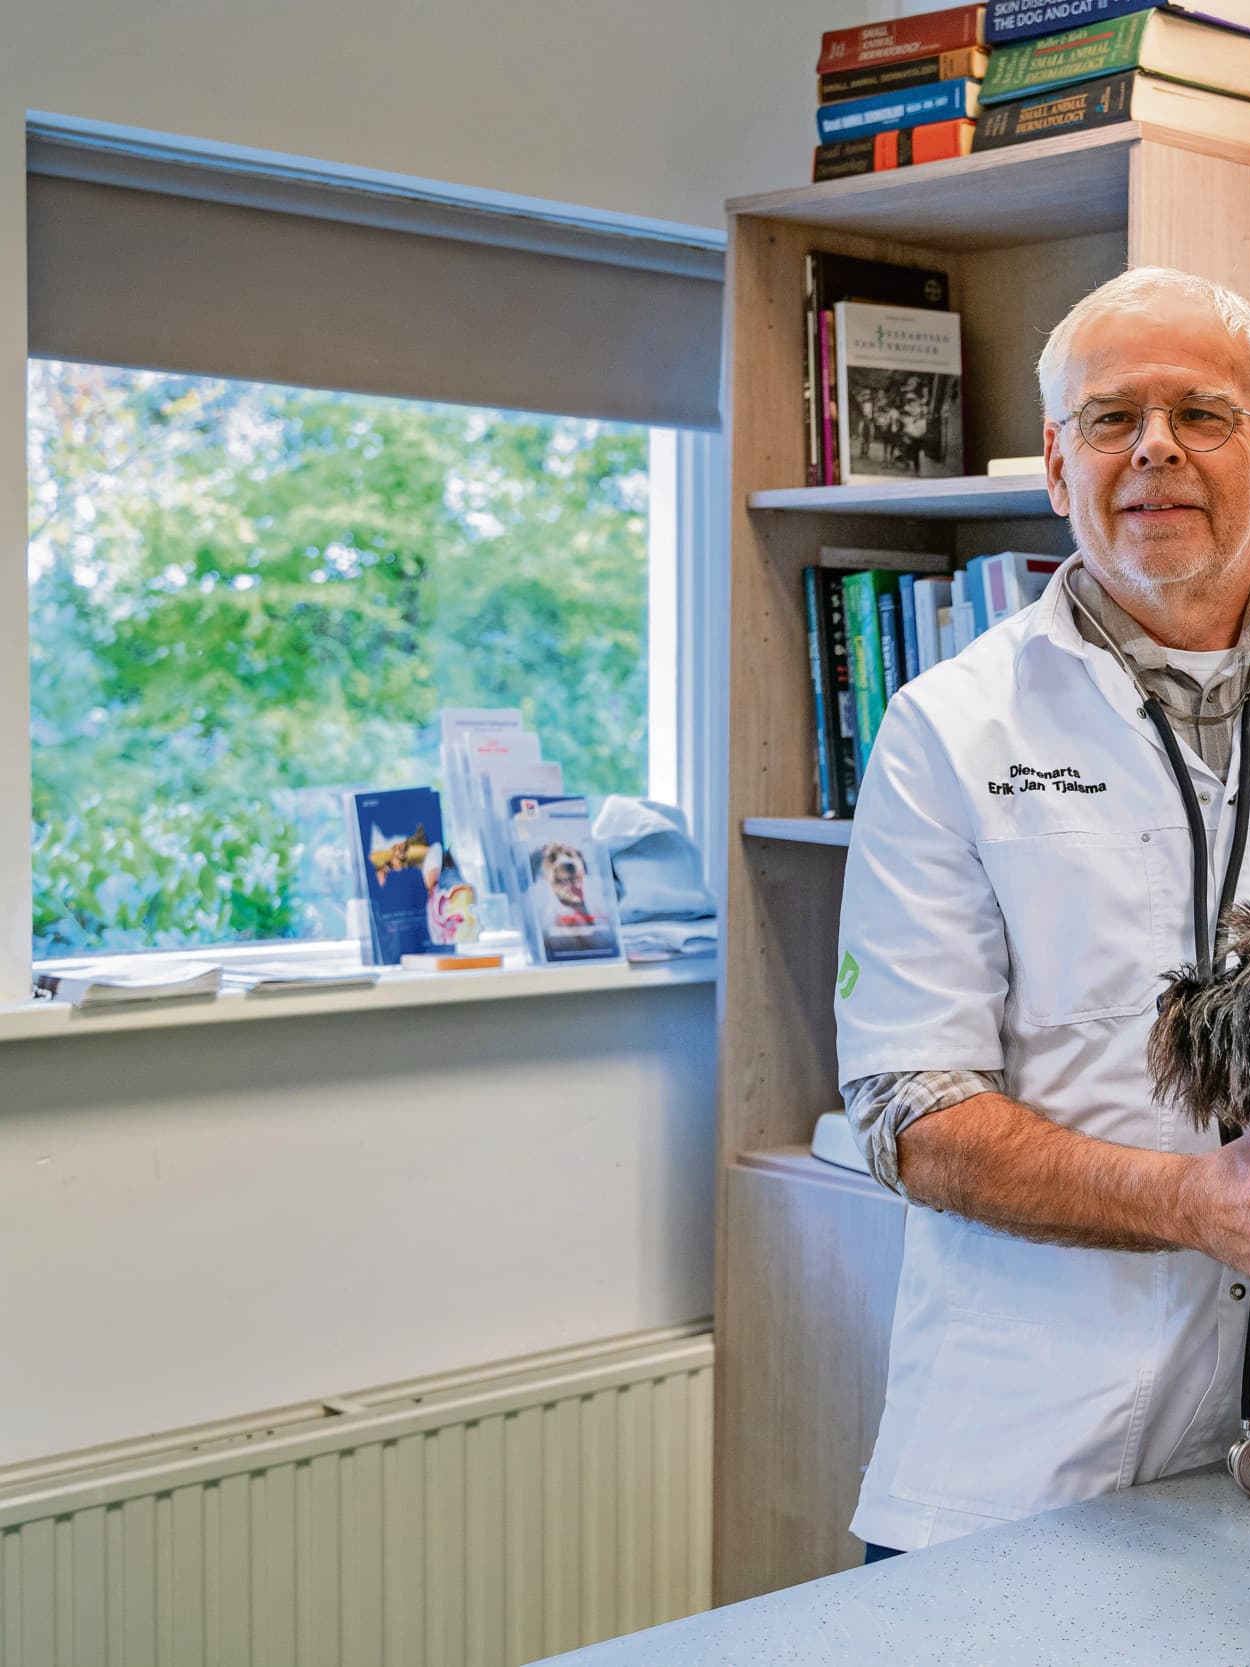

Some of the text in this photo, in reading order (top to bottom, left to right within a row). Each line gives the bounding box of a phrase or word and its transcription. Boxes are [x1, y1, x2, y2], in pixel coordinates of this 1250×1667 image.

[993, 15, 1015, 31] THE
[1016, 10, 1043, 27] DOG
[1044, 4, 1070, 21] AND
[1071, 0, 1092, 15] CAT
[994, 1, 1020, 17] SKIN
[1031, 53, 1065, 70] SMALL
[1069, 41, 1110, 60] ANIMAL
[1019, 106, 1048, 121] SMALL
[1051, 97, 1087, 115] ANIMAL
[1016, 111, 1085, 134] DERMATOLOGY
[1009, 764, 1081, 779] Dierenarts
[988, 779, 1107, 795] Erik Jan Tjalsma
